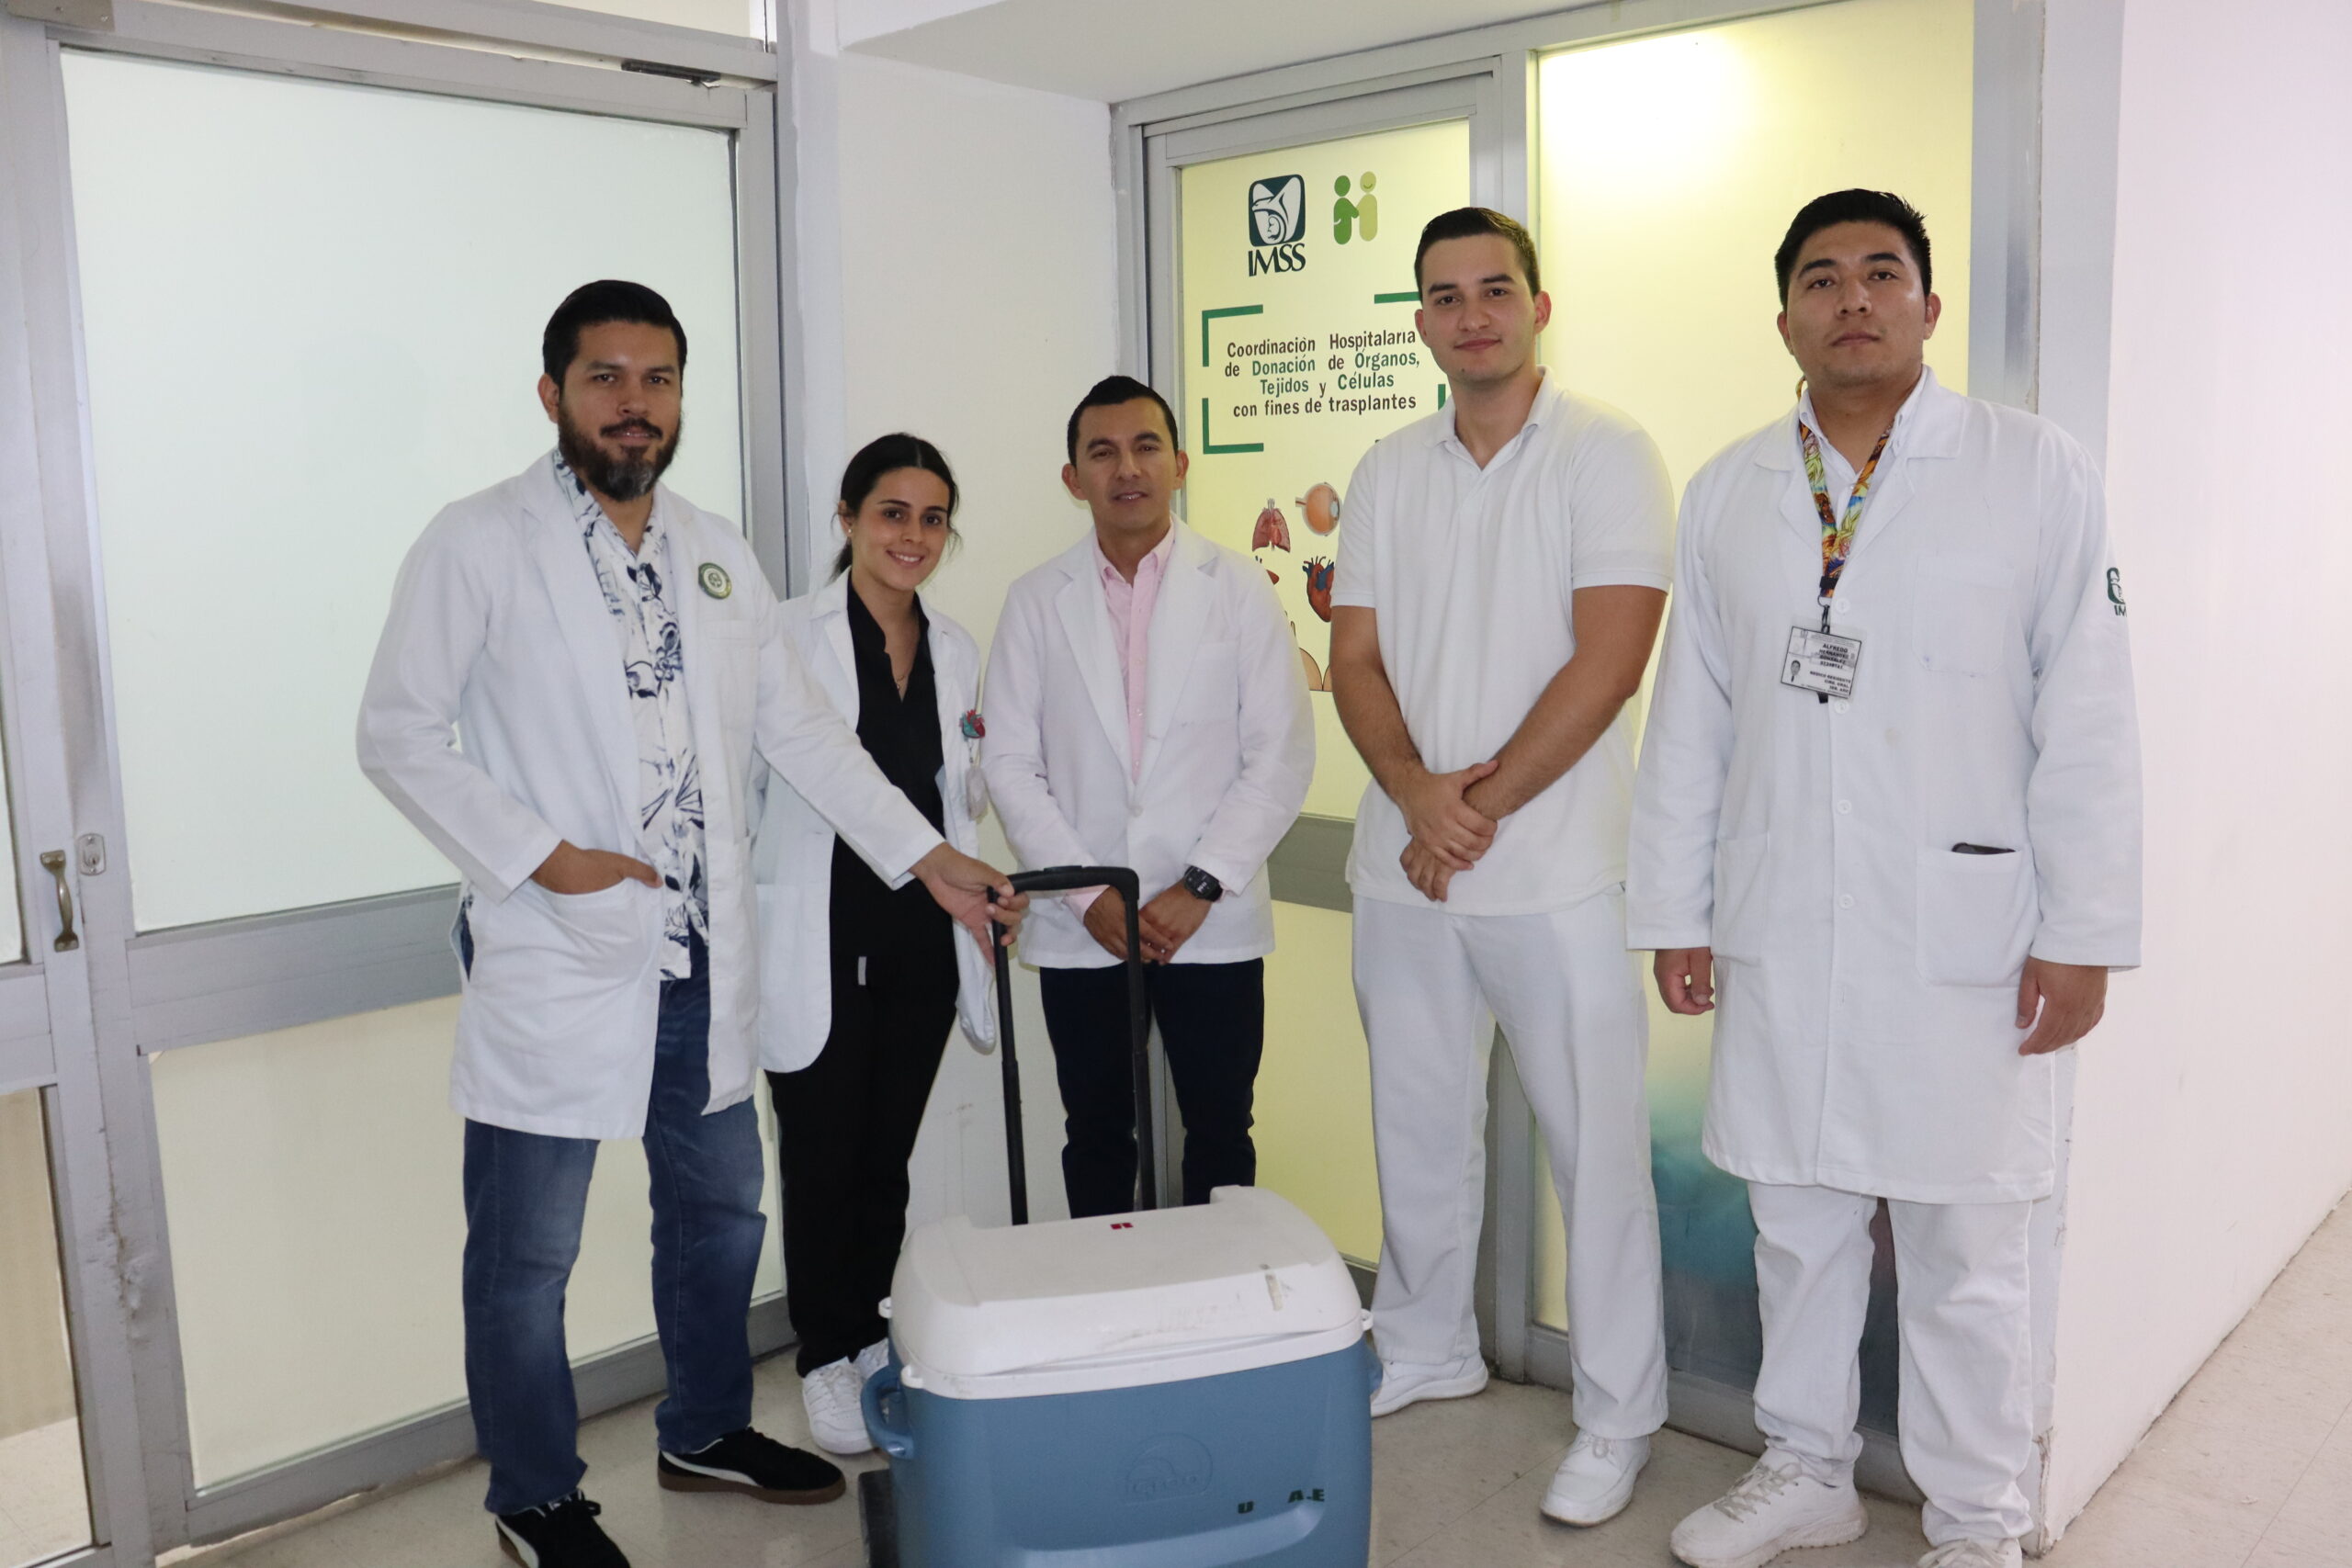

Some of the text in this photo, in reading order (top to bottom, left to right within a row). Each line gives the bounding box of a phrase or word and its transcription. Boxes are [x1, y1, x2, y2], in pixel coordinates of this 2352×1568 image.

[1249, 243, 1306, 277] IMSS
[1329, 330, 1416, 352] Hospitalaria
[1225, 348, 1419, 377] de Donación de Órganos,
[1261, 371, 1395, 399] Tejidos y Células
[1233, 393, 1417, 417] con fines de trasplantes
